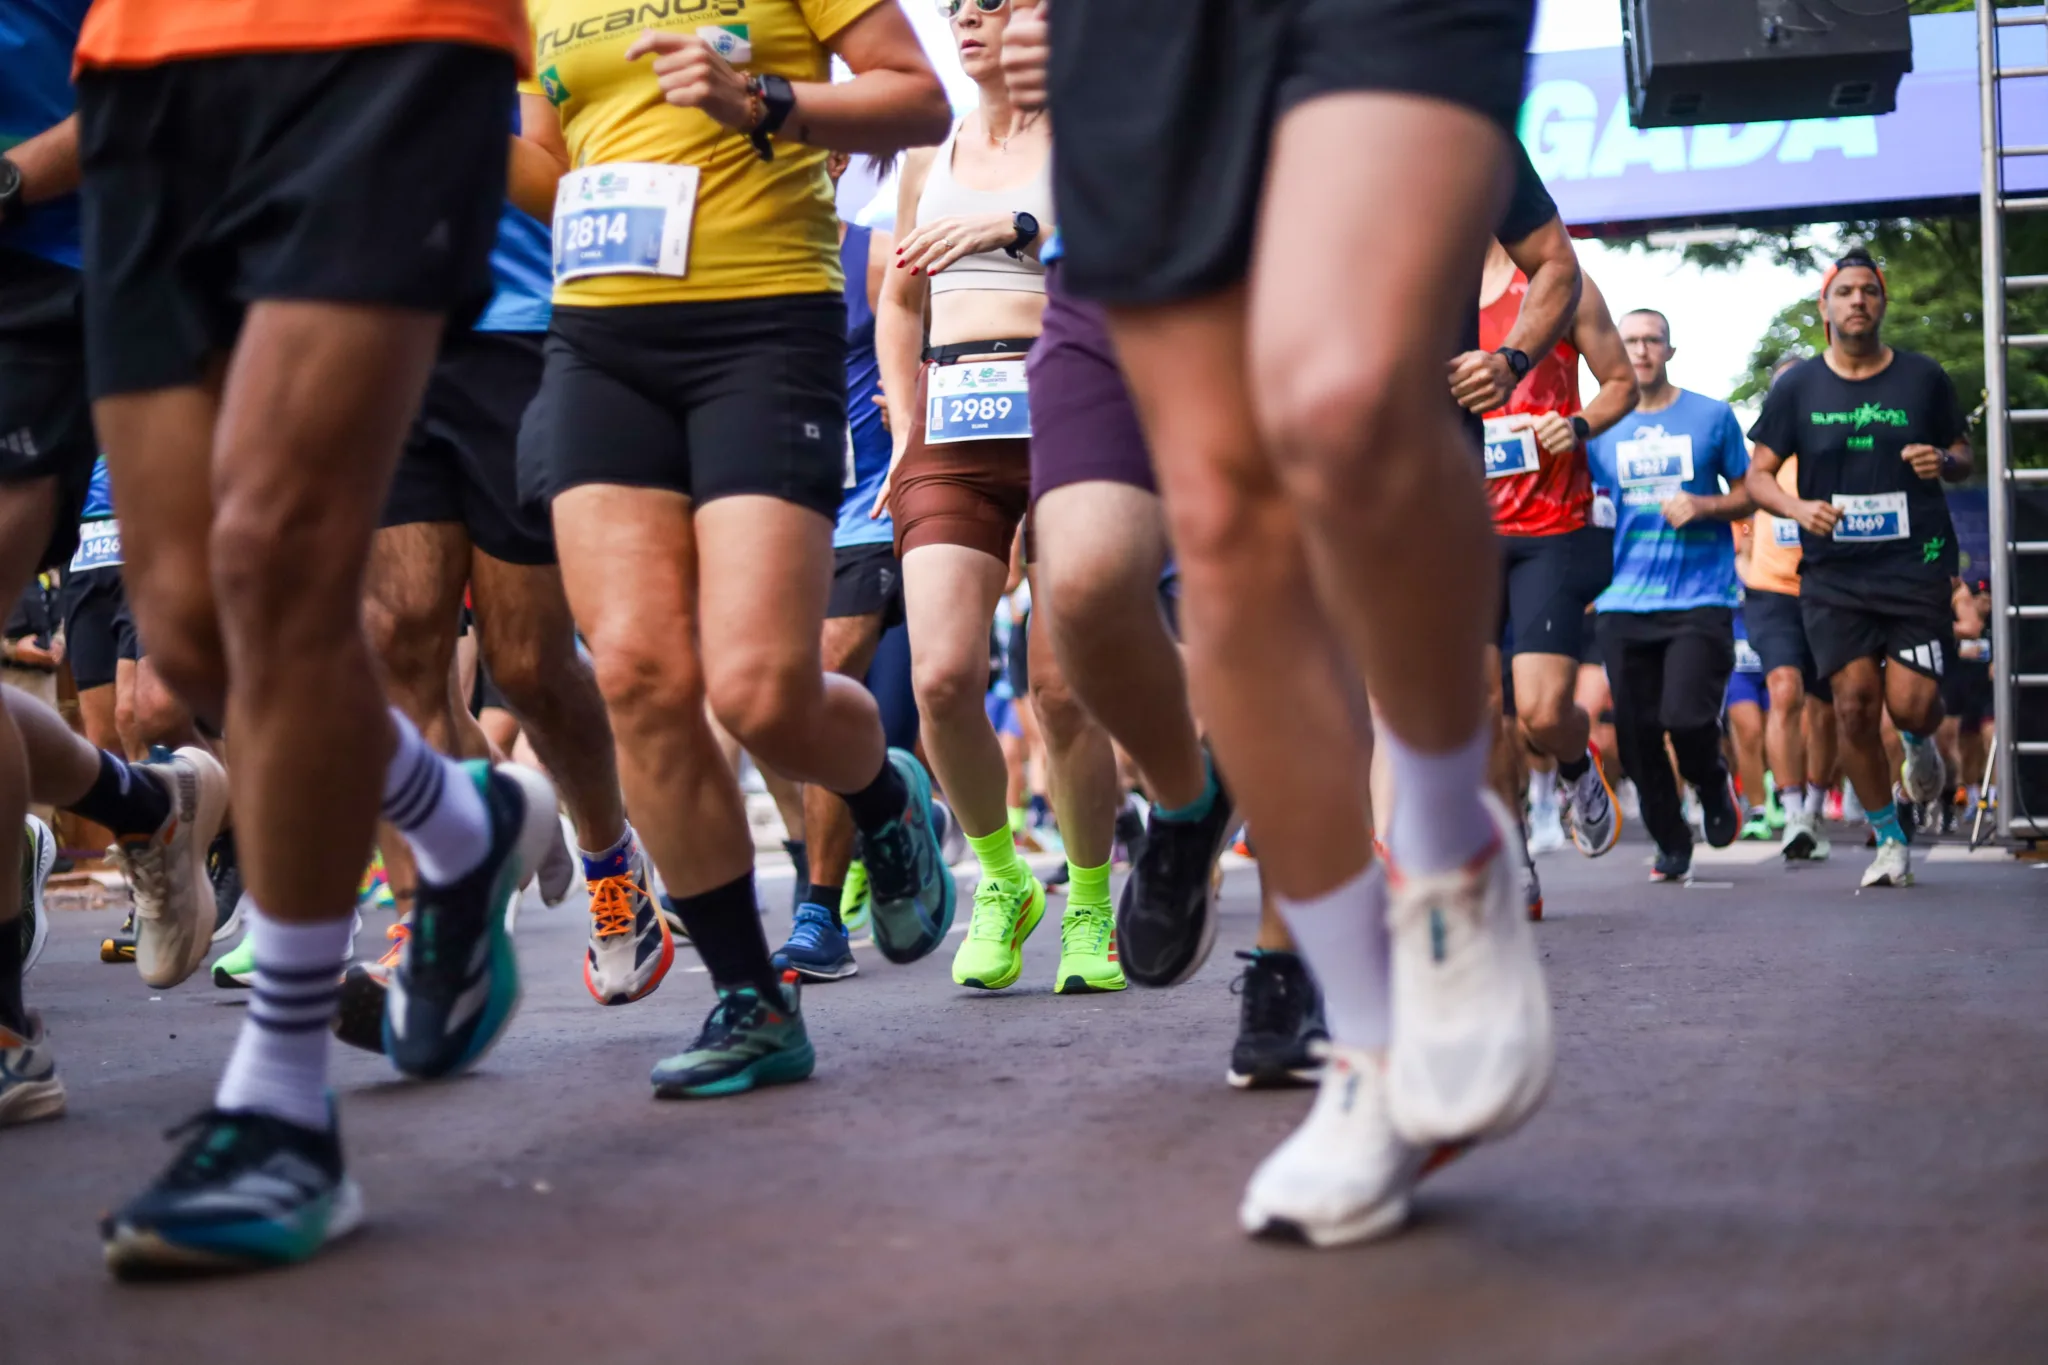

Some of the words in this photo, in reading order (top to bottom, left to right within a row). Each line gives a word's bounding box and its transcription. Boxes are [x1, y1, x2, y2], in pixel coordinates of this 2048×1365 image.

[565, 212, 627, 251] 2814
[949, 396, 1013, 423] 2989
[1846, 512, 1885, 532] 2669
[85, 537, 121, 558] 3426
